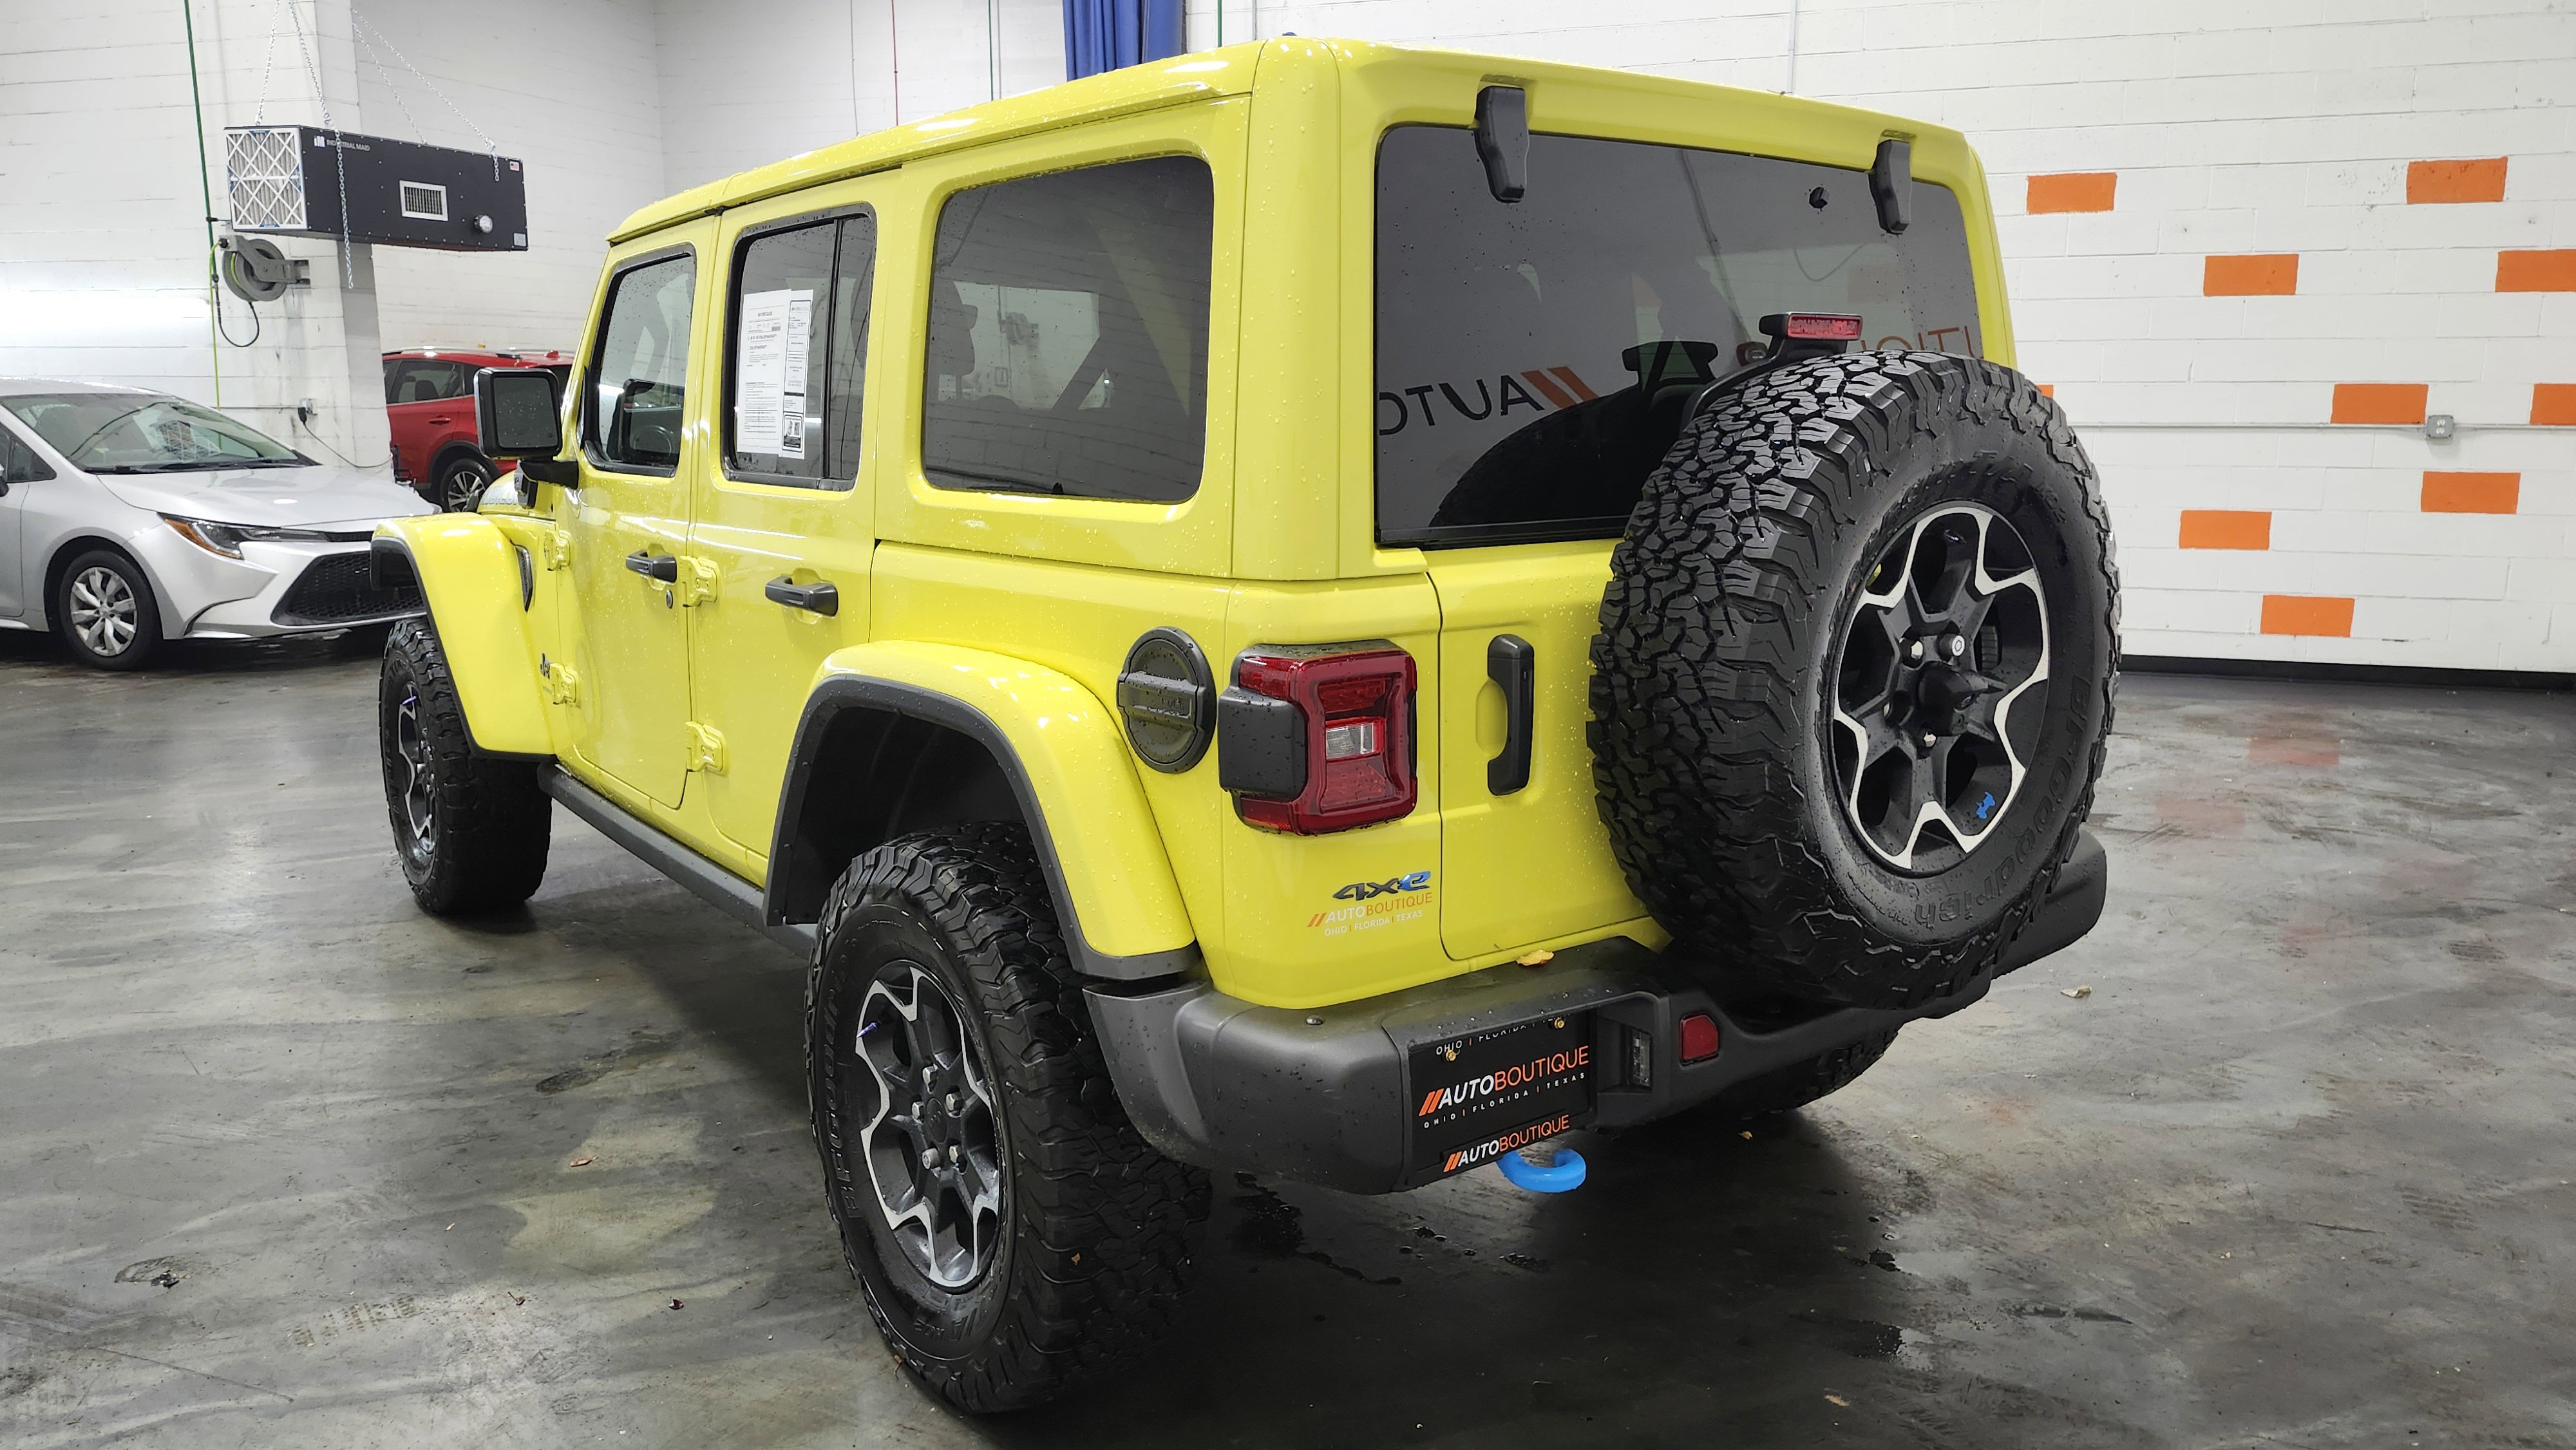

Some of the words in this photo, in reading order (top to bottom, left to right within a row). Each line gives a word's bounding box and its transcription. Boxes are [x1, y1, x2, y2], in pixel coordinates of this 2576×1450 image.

[1324, 925, 1347, 936] OHIO
[1354, 918, 1390, 931] FLORIDA
[1396, 909, 1423, 922] TEXAS
[1325, 892, 1433, 924] AUTOBOUTIQUE
[1423, 1113, 1457, 1129] OHIO
[1472, 1089, 1529, 1113] FLORIDA
[1546, 1071, 1585, 1089] TEXAS
[1437, 1045, 1589, 1109] AUTOBOUTIQUE
[1457, 1114, 1570, 1167] AUTOBOUTIQUE
